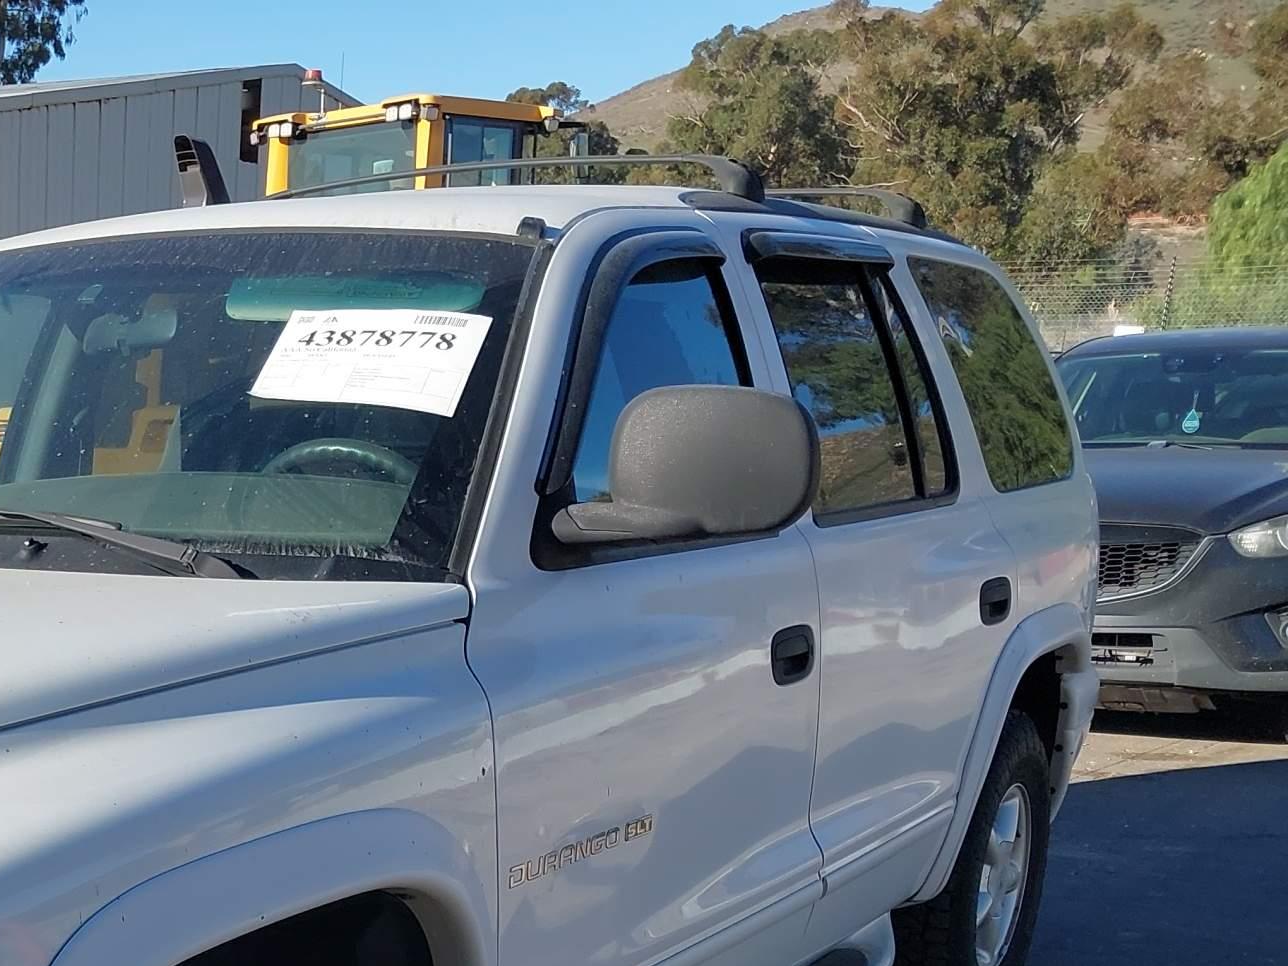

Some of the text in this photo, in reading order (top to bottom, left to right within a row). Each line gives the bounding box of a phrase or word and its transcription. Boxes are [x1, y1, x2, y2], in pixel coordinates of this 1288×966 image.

[298, 329, 457, 351] 43878778
[509, 814, 653, 889] DURANGO SLT
